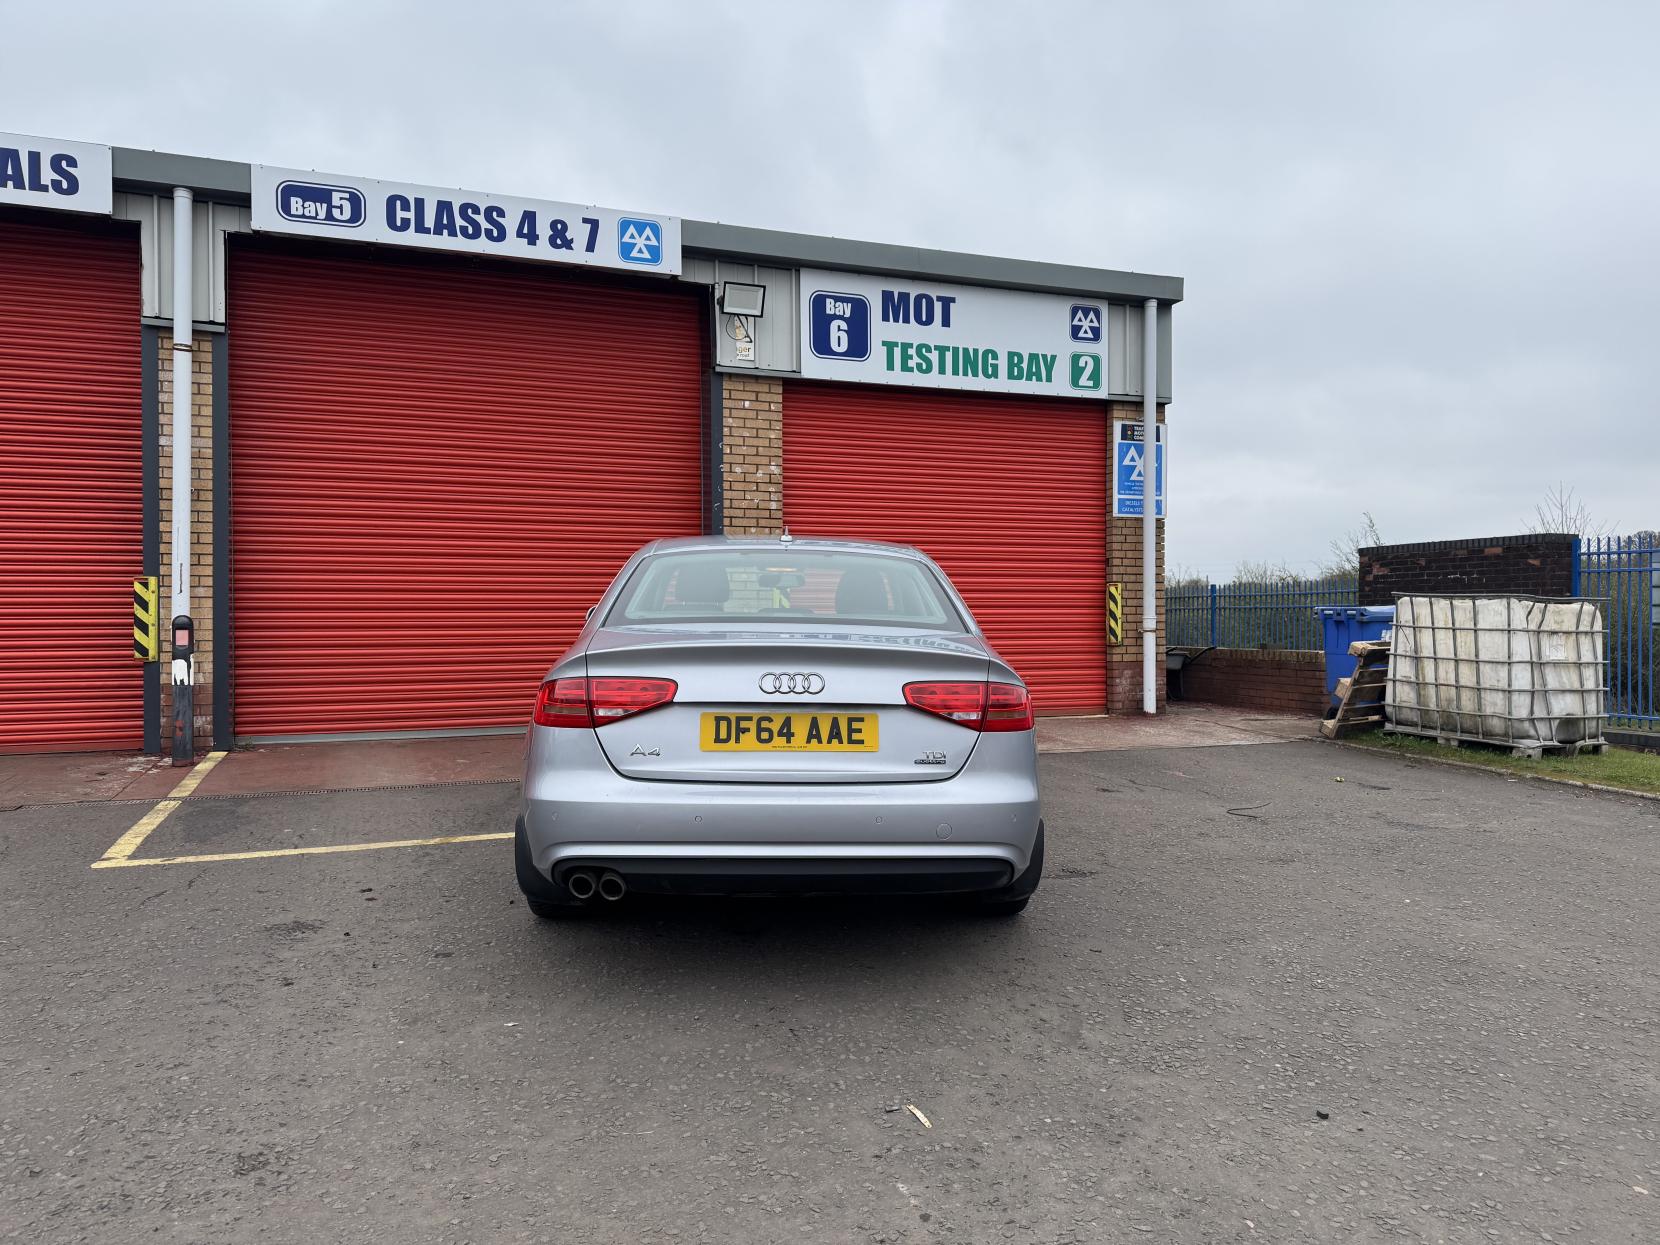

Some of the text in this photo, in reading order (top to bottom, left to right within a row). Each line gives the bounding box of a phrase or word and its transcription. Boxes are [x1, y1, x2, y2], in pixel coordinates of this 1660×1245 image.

[0, 147, 79, 195] ALS
[290, 191, 352, 220] Bay 5
[386, 194, 600, 252] CLASS 4 & 7
[825, 298, 851, 318] Bay
[881, 290, 956, 328] MOT
[829, 320, 849, 352] 6
[881, 340, 1058, 383] TESTING BAY
[1078, 356, 1095, 387] 2
[713, 716, 865, 744] DF64 AAE
[630, 743, 661, 756] A4
[922, 750, 947, 759] TDI
